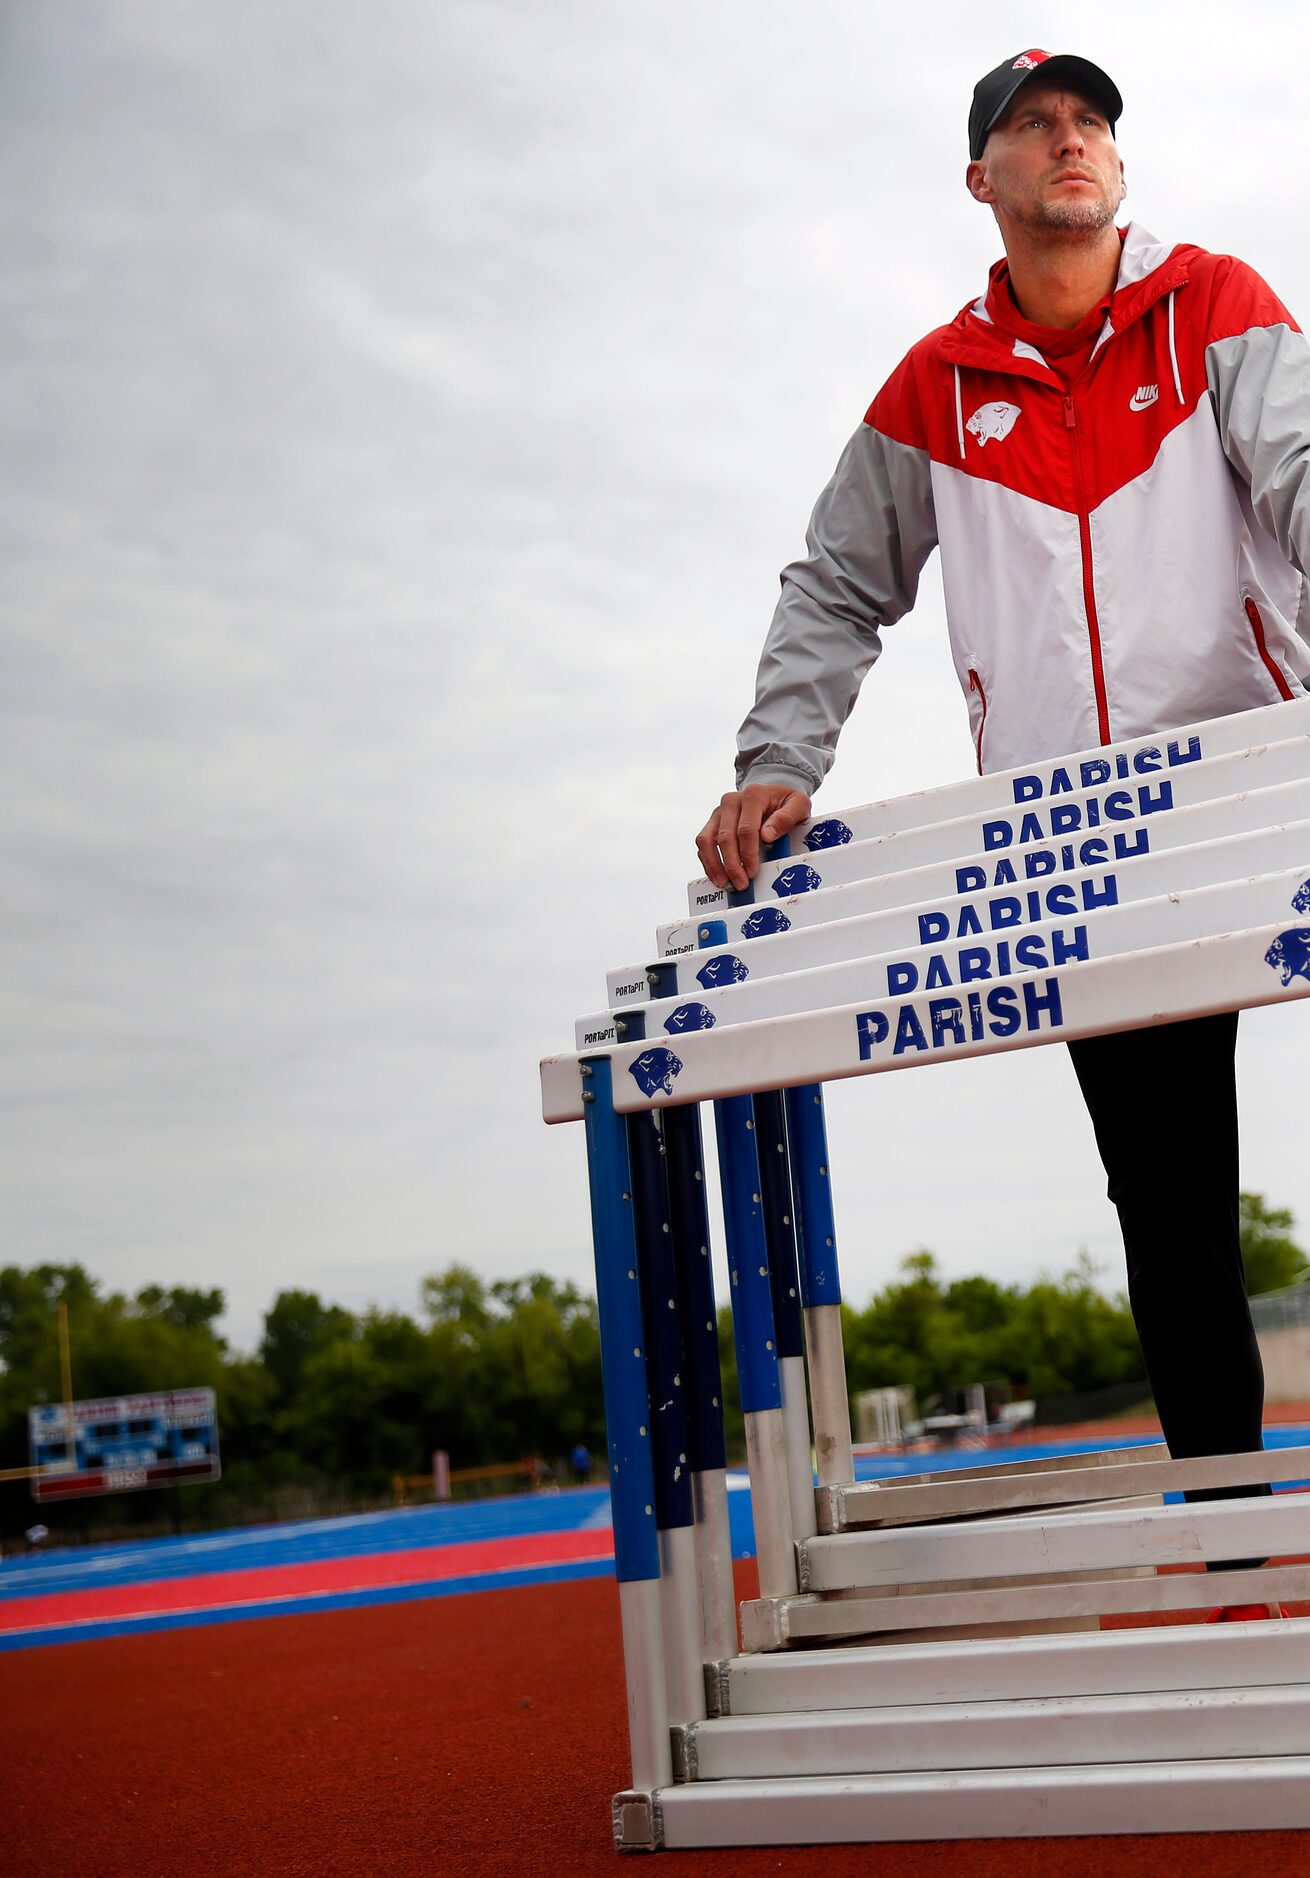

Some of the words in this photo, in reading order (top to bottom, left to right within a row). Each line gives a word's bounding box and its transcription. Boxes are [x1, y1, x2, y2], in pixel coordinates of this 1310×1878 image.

[1135, 384, 1159, 400] NIK
[982, 780, 1174, 852] PARISH
[918, 875, 1120, 945] PARISH
[886, 925, 1090, 997] PARISH
[856, 977, 1064, 1061] PARISH
